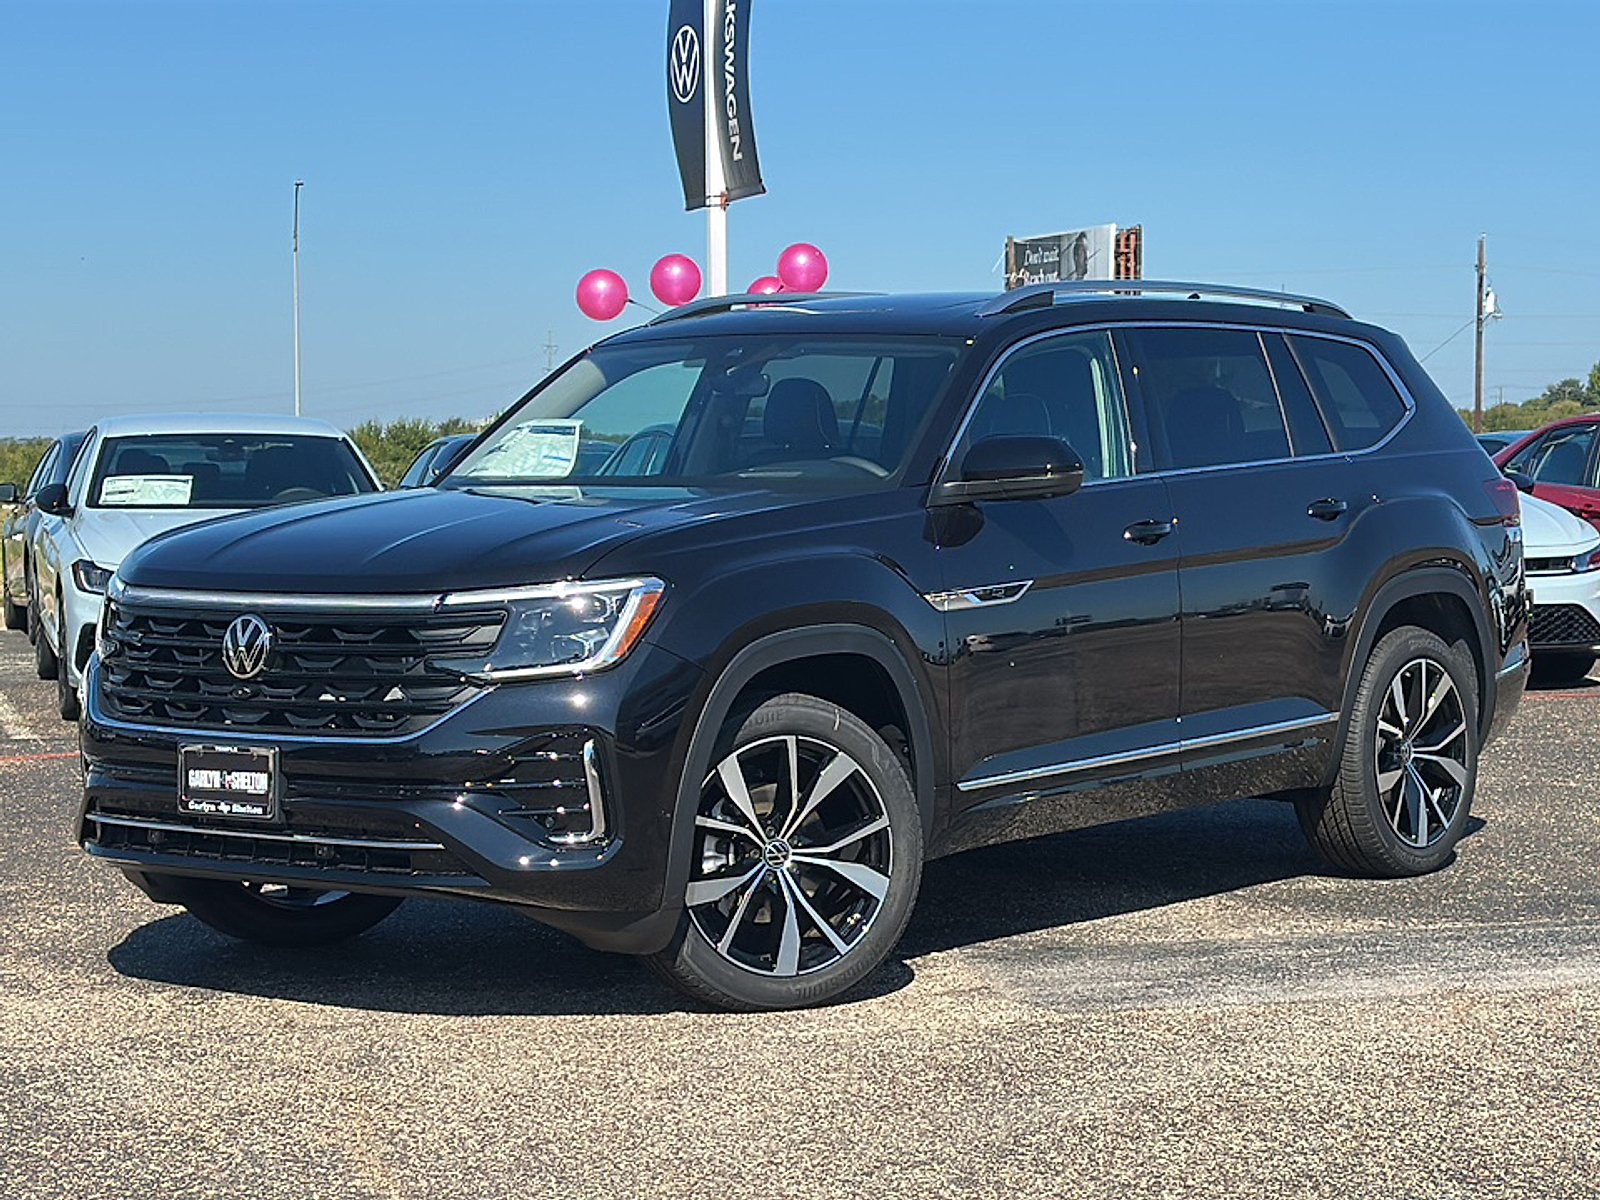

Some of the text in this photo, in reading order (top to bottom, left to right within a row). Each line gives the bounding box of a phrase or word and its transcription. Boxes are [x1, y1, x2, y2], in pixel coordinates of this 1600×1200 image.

[724, 0, 742, 161] KSWAGEN
[223, 614, 269, 679] VW
[189, 769, 268, 790] GARLYN SHELTON
